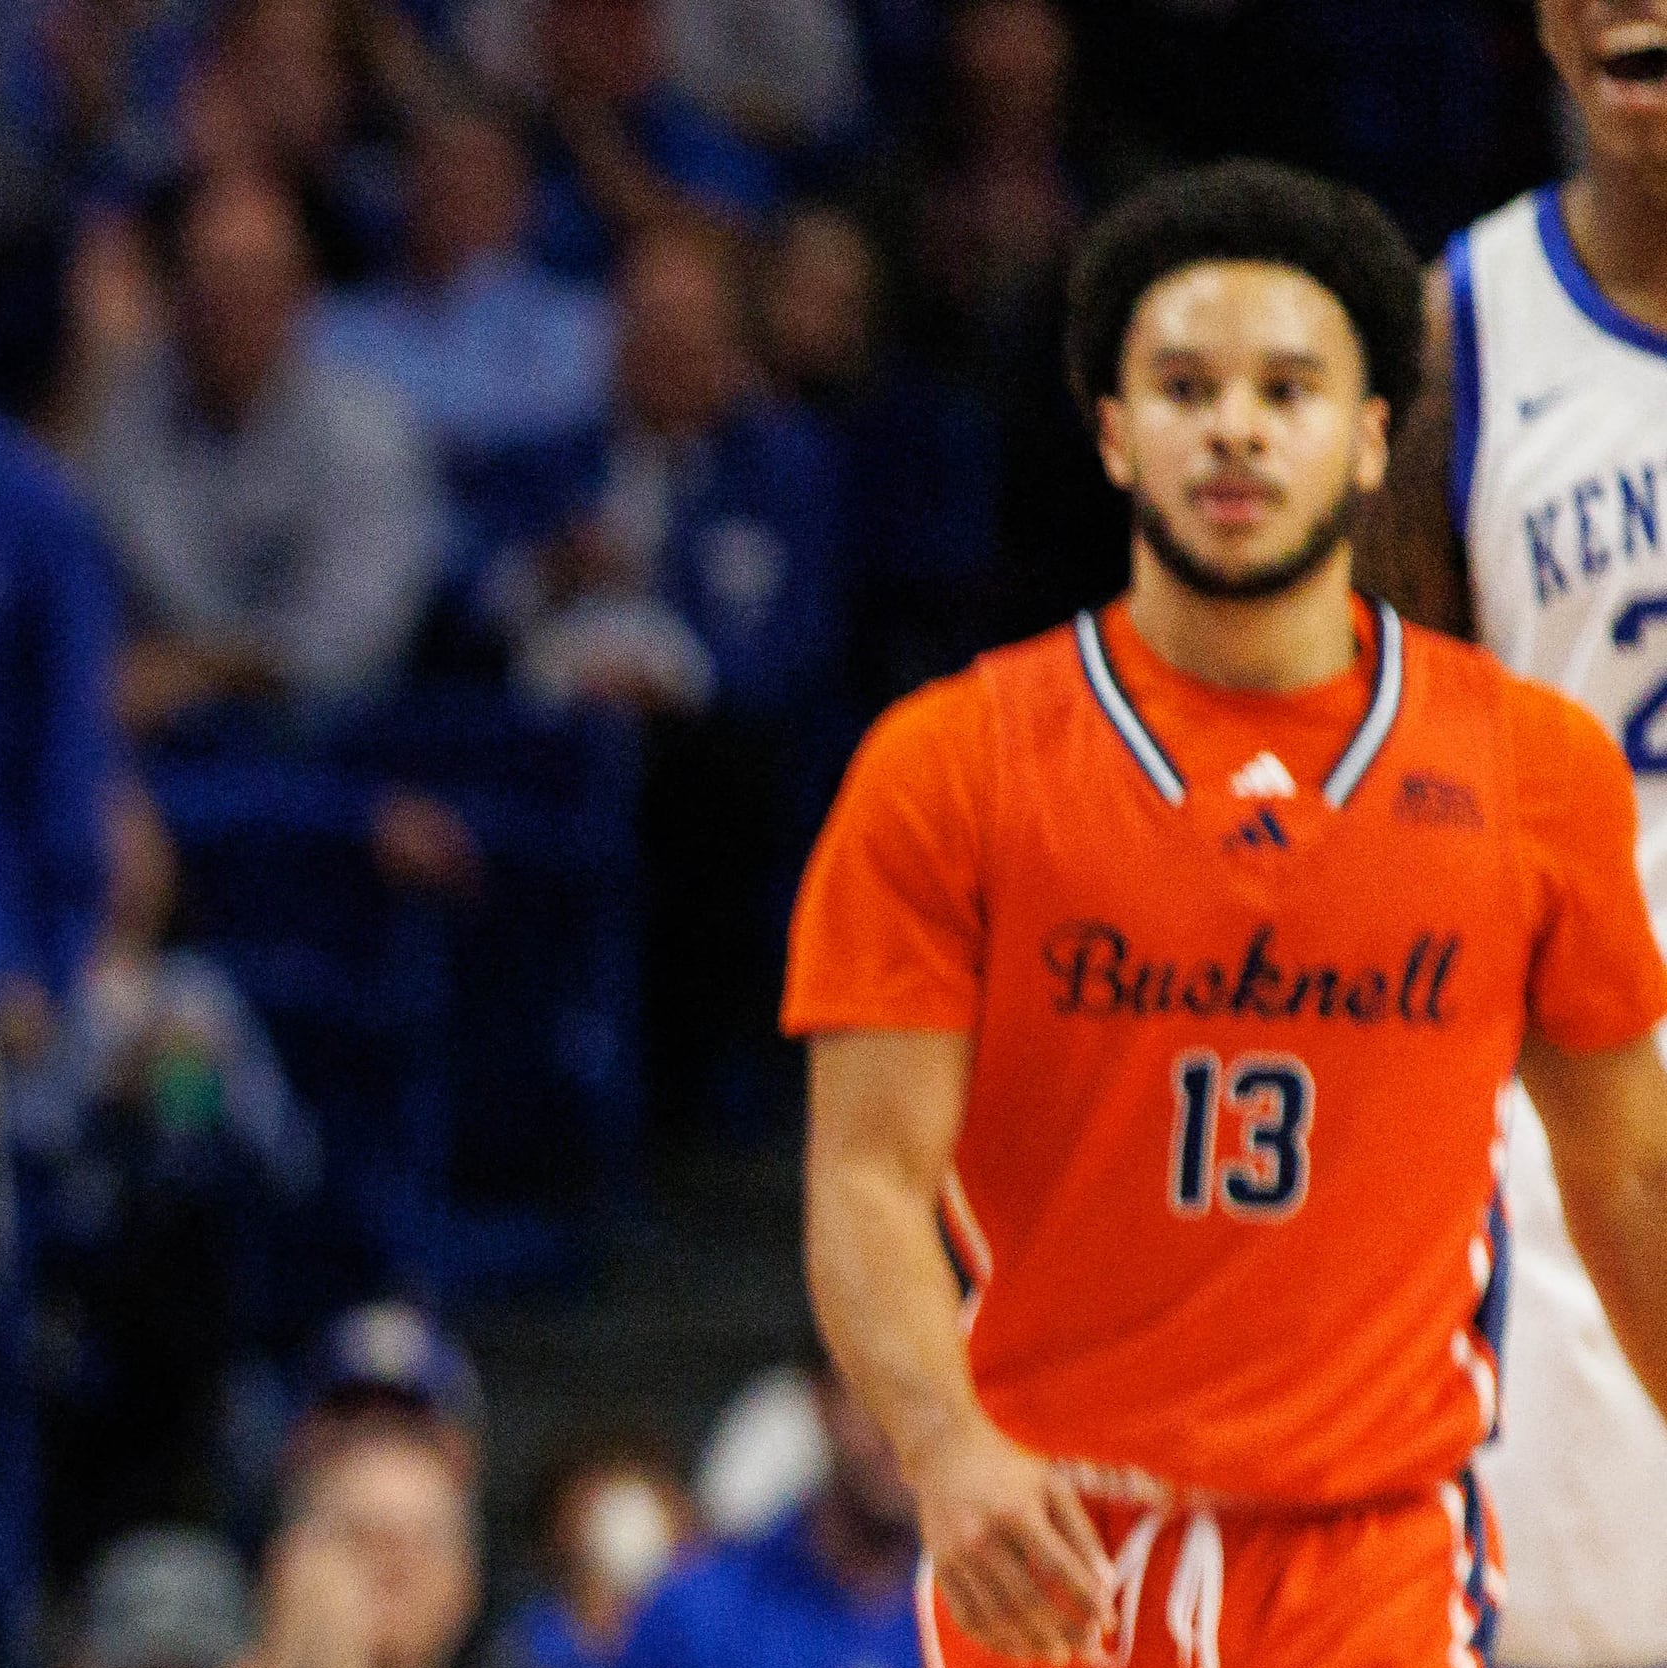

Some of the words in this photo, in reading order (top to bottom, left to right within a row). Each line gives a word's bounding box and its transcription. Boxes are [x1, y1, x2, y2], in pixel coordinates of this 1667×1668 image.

[1523, 460, 1667, 608] KEN
[1041, 916, 1461, 1026] Bucknell
[1169, 1046, 1317, 1224] 13
